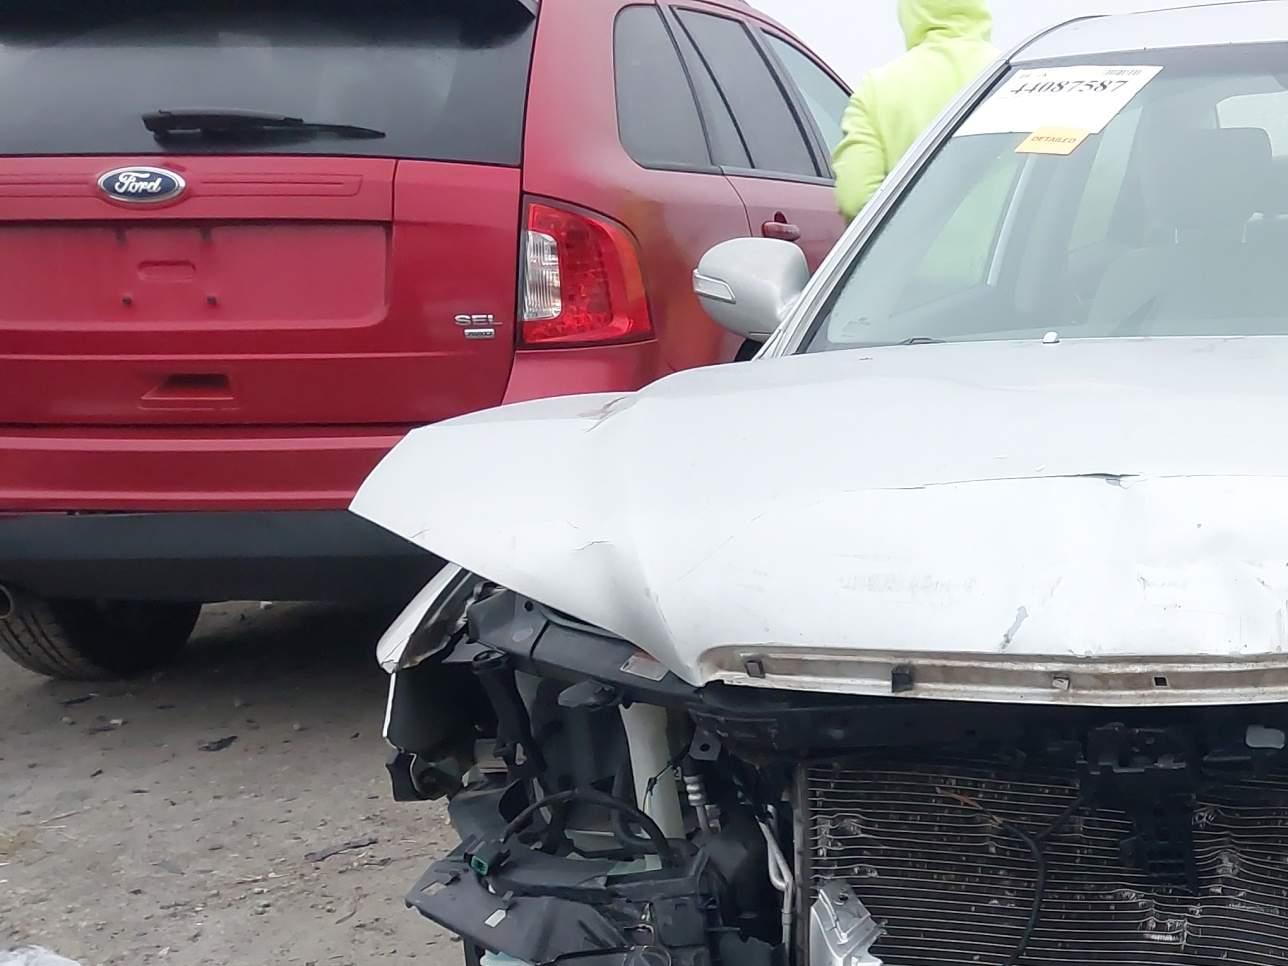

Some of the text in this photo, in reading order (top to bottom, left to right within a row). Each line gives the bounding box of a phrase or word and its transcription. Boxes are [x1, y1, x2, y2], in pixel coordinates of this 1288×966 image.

[1010, 80, 1128, 95] 44087587
[114, 172, 162, 193] Ford
[454, 314, 503, 326] SEL
